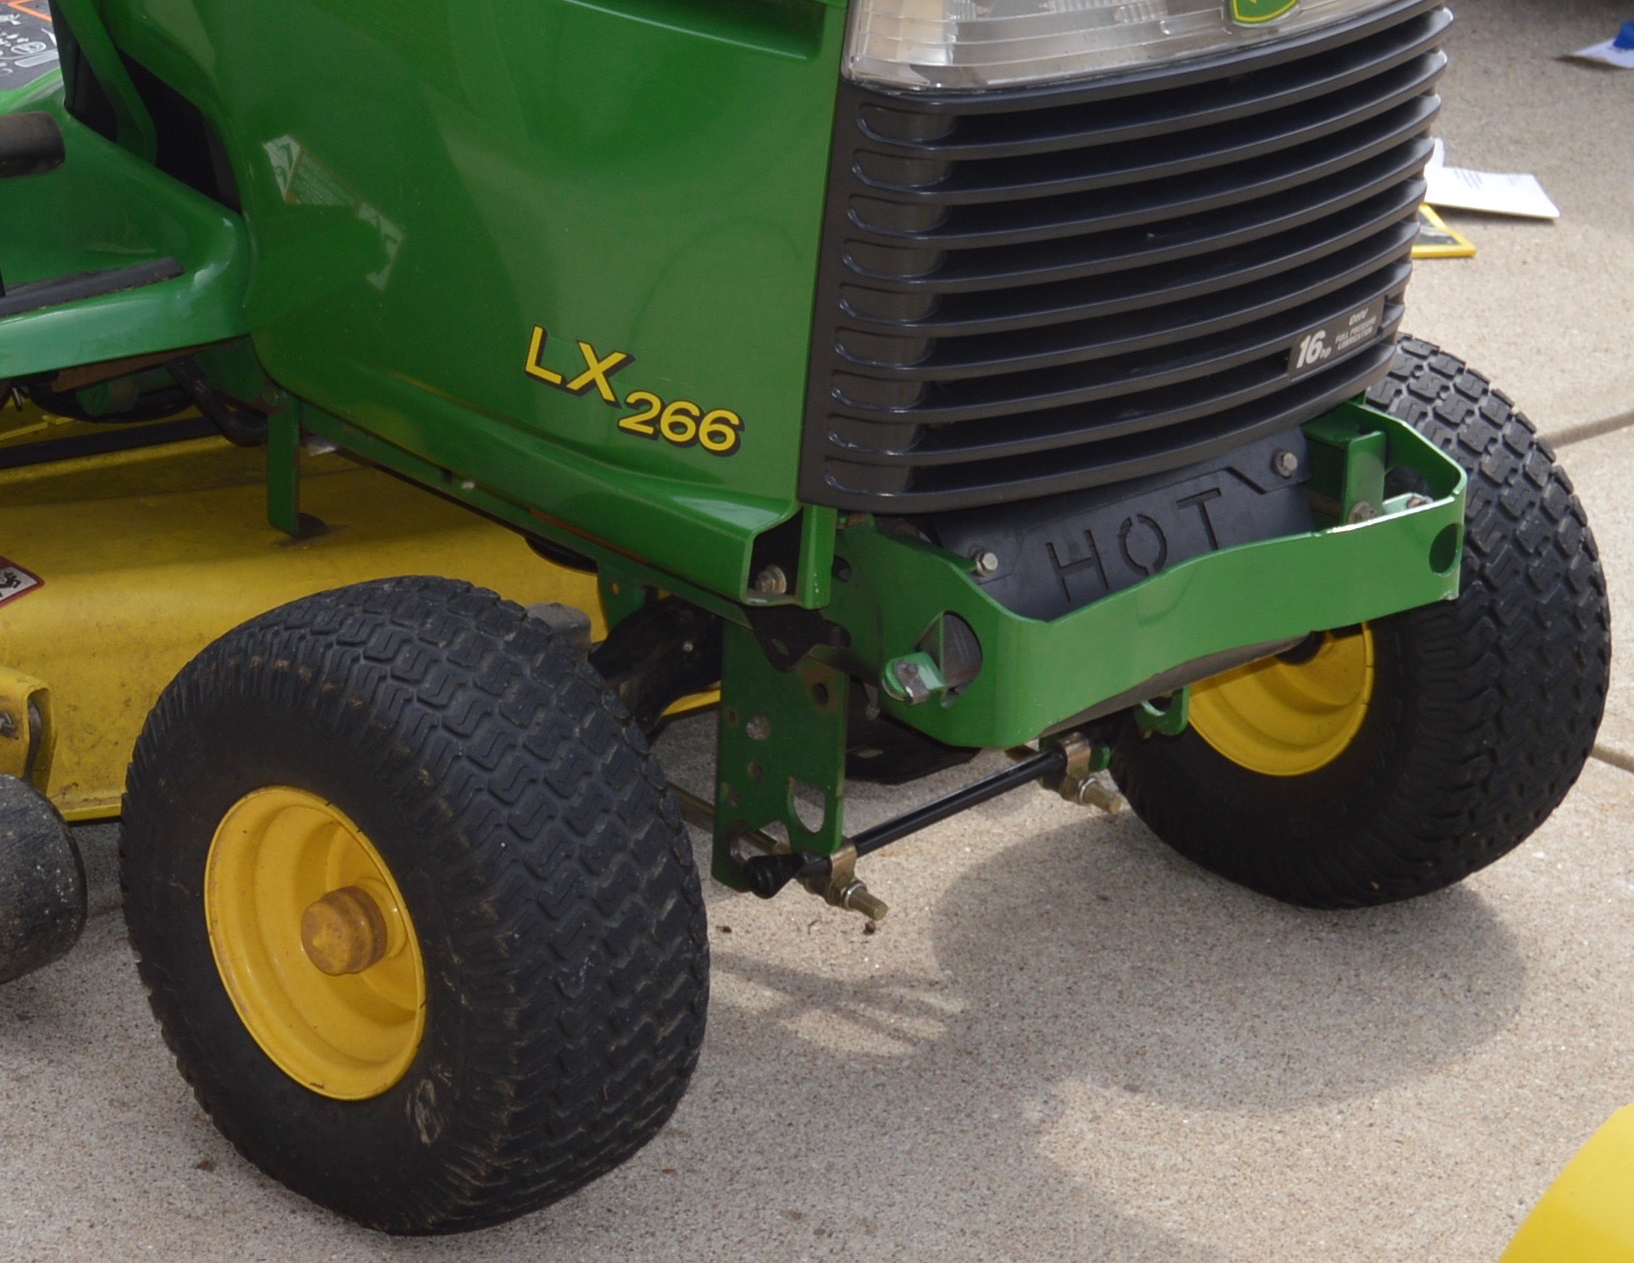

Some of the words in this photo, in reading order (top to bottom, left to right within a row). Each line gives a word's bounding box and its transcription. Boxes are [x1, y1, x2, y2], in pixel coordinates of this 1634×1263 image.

[525, 324, 636, 409] LX
[618, 390, 745, 457] 266
[1296, 330, 1326, 369] 16
[1045, 487, 1222, 602] HOT
